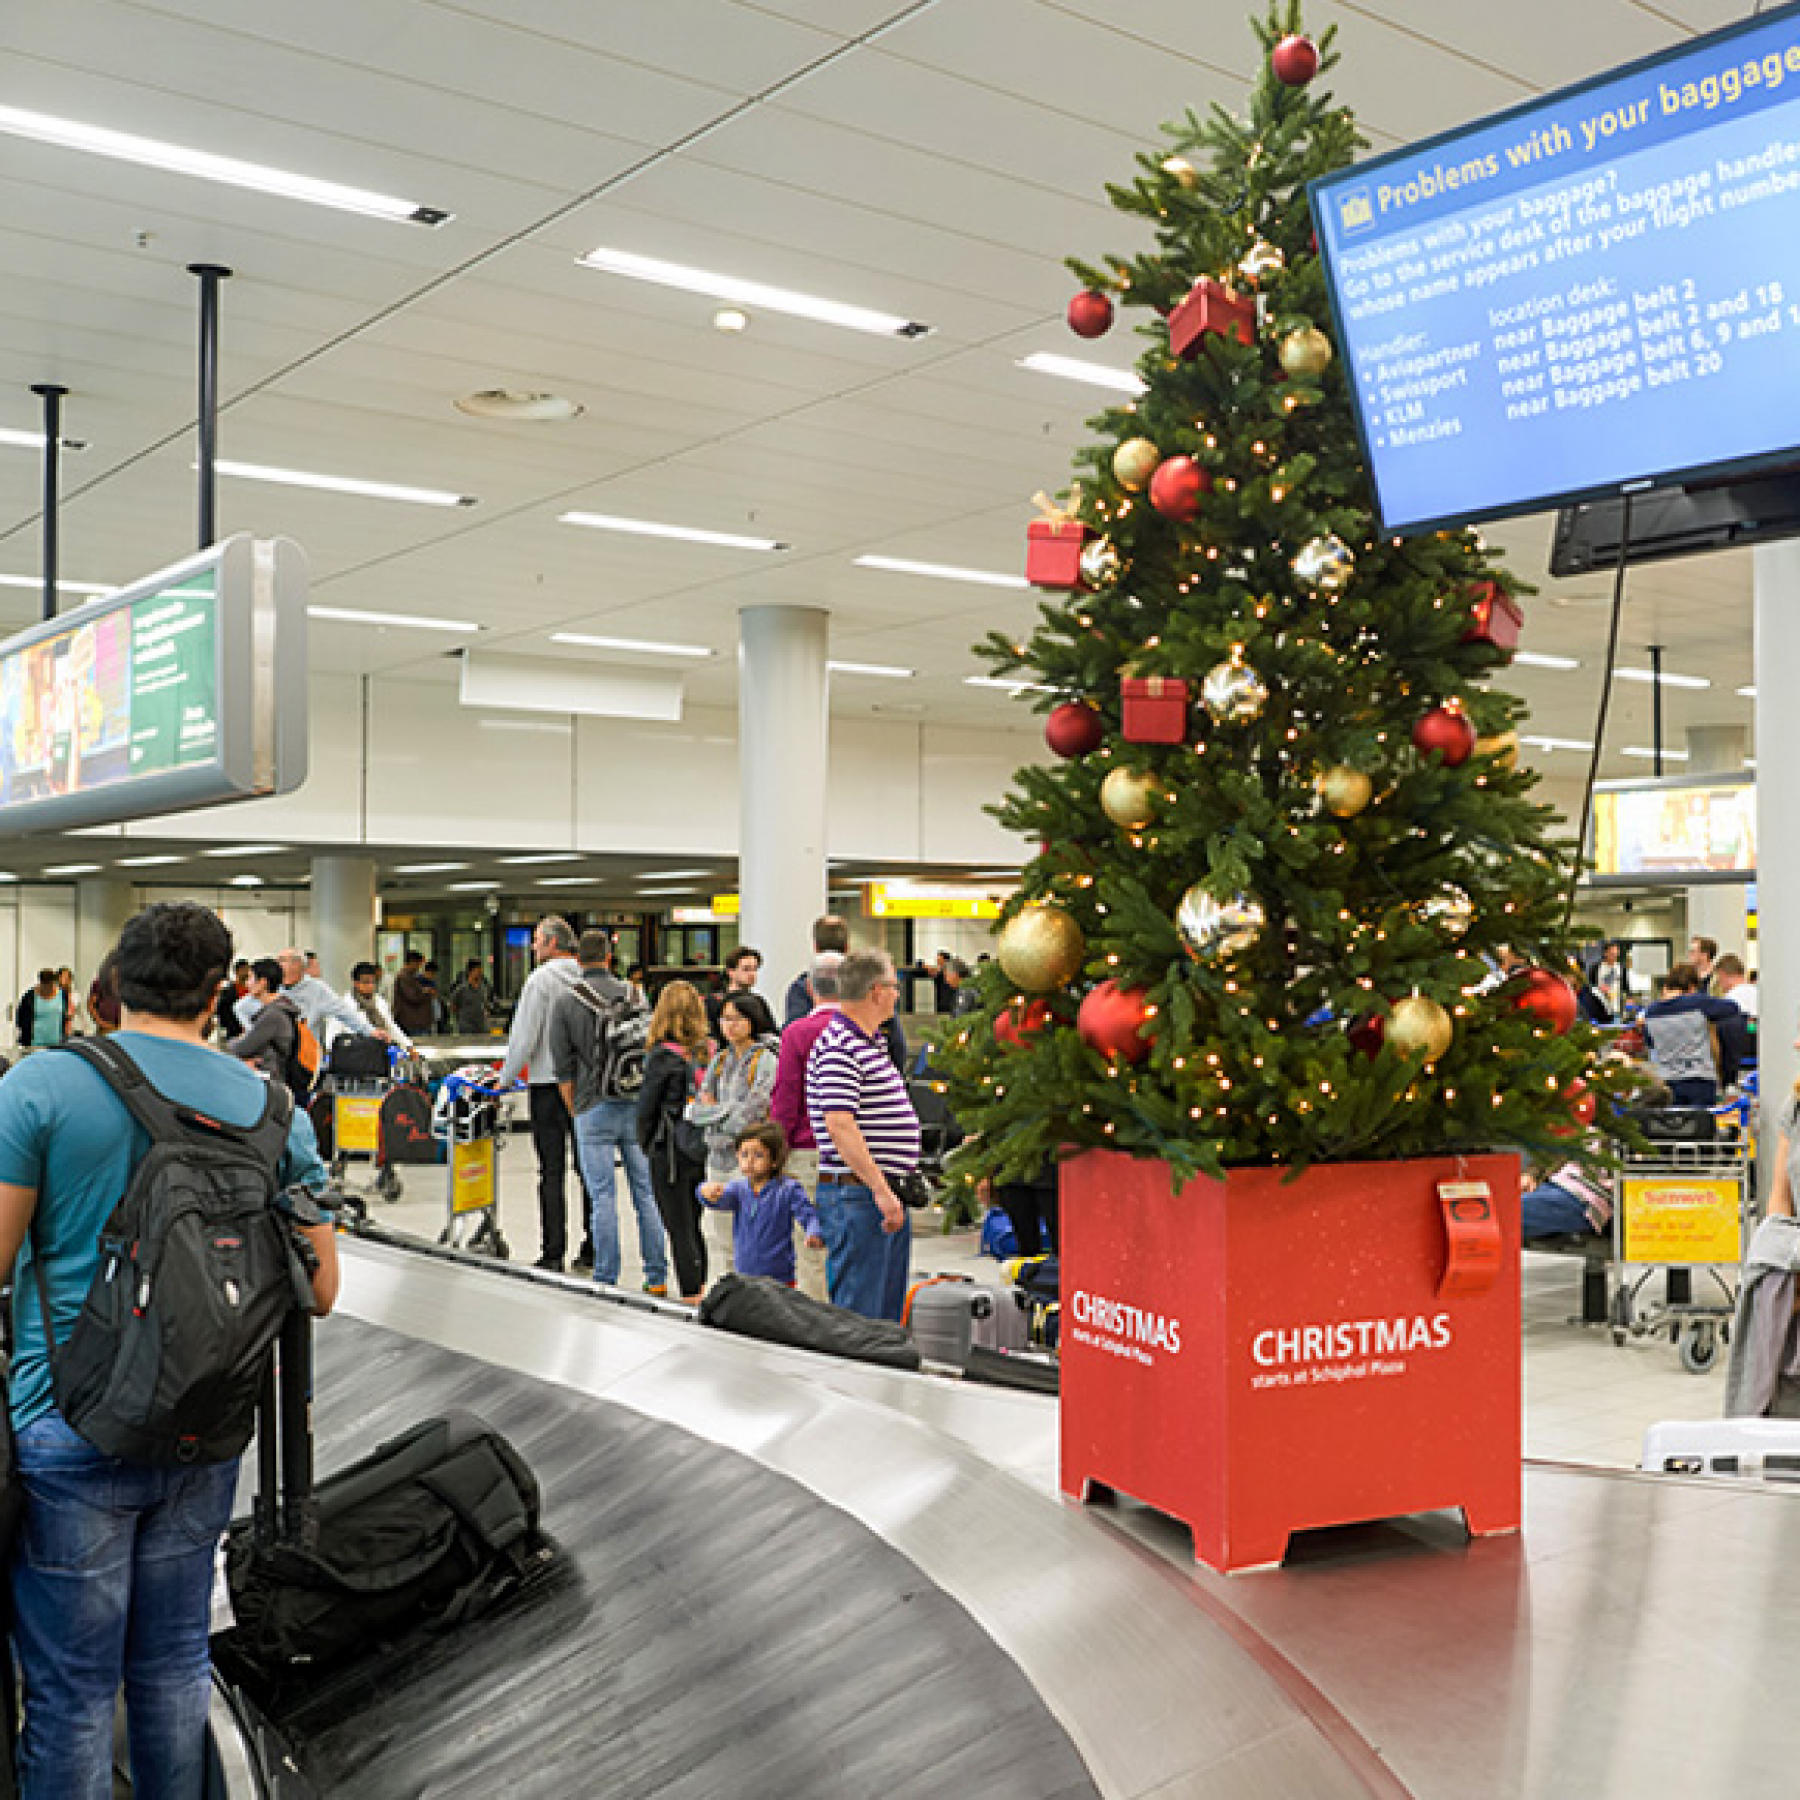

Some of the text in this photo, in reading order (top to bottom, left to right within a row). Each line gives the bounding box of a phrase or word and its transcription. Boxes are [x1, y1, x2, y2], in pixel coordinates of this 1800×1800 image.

[1378, 46, 1800, 213] Problems with your baggage
[1340, 170, 1617, 276] Problems with your baggage?
[1343, 141, 1800, 298] Go to the service desk of the baggage handle
[1349, 291, 1406, 320] whose
[1409, 275, 1459, 301] name
[1464, 250, 1540, 288] appears
[1545, 231, 1593, 264] after
[1598, 217, 1646, 251] your
[1652, 194, 1715, 230] flight
[1488, 276, 1617, 327] location desk:
[1494, 278, 1695, 350] near Baggage belt 2
[1498, 281, 1783, 374] near Baggage belt 2 and 18
[1380, 366, 1468, 404] Swissport
[1502, 372, 1545, 397] near
[1549, 350, 1637, 386] Baggage
[1641, 335, 1685, 363] belt
[1716, 321, 1732, 344] 9
[1738, 307, 1781, 338] and
[1507, 350, 1722, 419] near Baggage belt 20
[1384, 400, 1425, 425] KLM
[1389, 417, 1462, 447] Menzies
[1073, 1290, 1180, 1354] CHRISTMAS
[1253, 1312, 1451, 1366] CHRISTMAS
